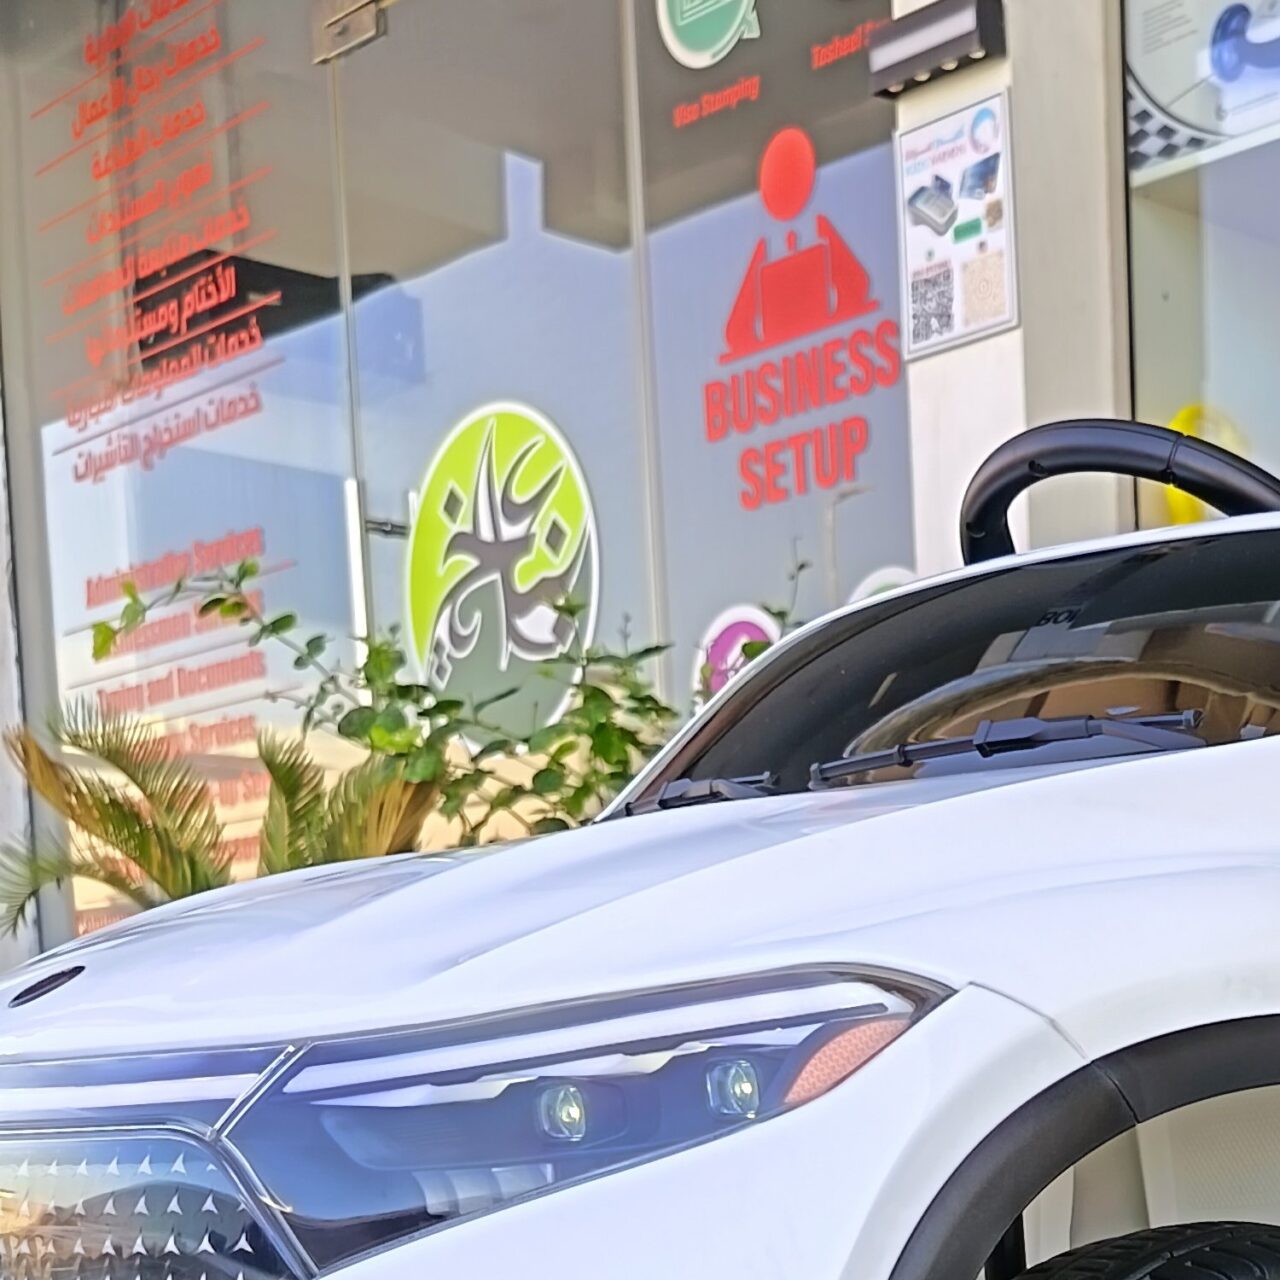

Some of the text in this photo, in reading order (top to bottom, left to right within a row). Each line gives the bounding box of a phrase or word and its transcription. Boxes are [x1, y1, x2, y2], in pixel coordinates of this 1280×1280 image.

[180, 264, 237, 336] الأختام
[204, 315, 265, 369] خدمات
[203, 380, 263, 431] خدمات
[704, 319, 900, 444] BUSINESS
[738, 415, 869, 512] SETUP
